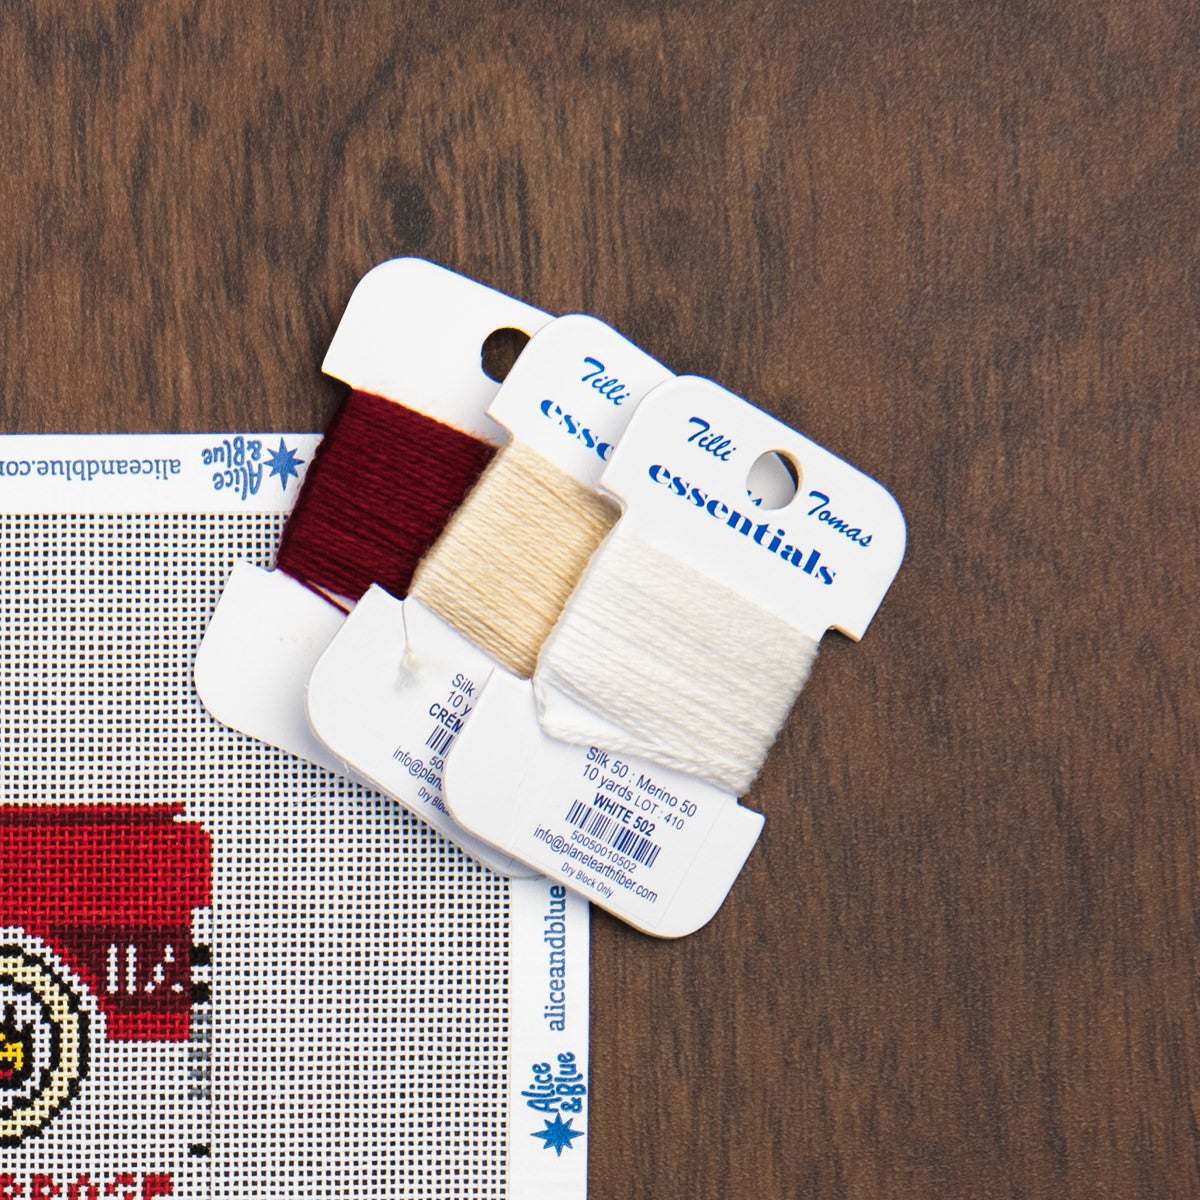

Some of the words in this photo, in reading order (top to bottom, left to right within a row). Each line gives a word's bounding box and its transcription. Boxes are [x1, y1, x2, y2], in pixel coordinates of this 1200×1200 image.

[581, 356, 631, 406] Tilli
[212, 462, 262, 500] Alice
[688, 416, 737, 462] Tilli
[808, 490, 872, 548] Tomas
[648, 464, 838, 586] essentials
[583, 764, 599, 781] 10
[597, 776, 634, 801] yards
[634, 795, 660, 815] LOT
[663, 813, 685, 830] 410
[586, 745, 610, 769] Silk
[610, 760, 629, 779] 50
[635, 774, 678, 808] Merino
[679, 799, 698, 818] 50
[593, 792, 634, 825] WHITE
[632, 815, 656, 837] 502
[533, 824, 658, 904] info@planetearthfiber.com
[570, 829, 637, 874] 50050010502
[560, 862, 577, 878] Dry
[574, 869, 597, 889] Block
[596, 881, 614, 899] Only
[521, 1062, 555, 1113] Alice
